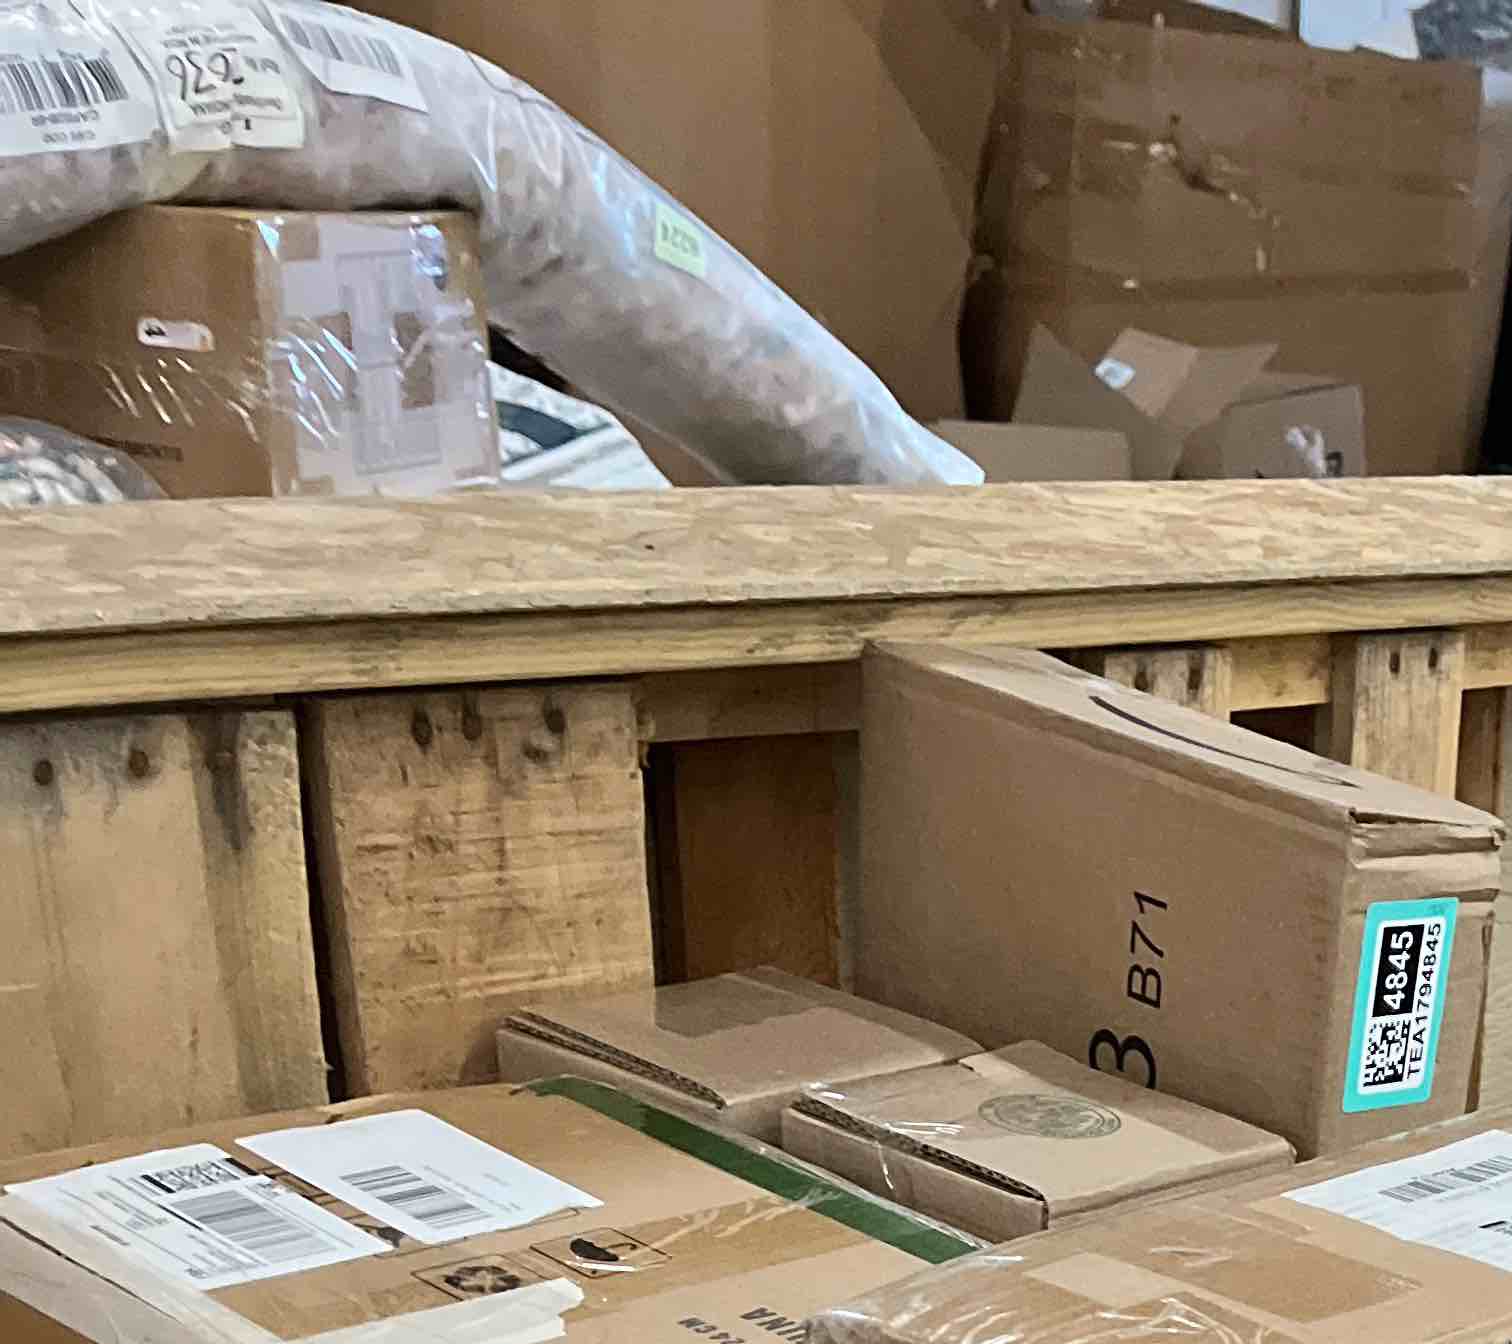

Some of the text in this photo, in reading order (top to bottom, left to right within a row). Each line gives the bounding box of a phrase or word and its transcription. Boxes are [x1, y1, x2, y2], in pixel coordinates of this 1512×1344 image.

[1126, 890, 1168, 1009] B71
[1383, 930, 1414, 1011] 4845
[1407, 922, 1442, 1079] TEA1794845
